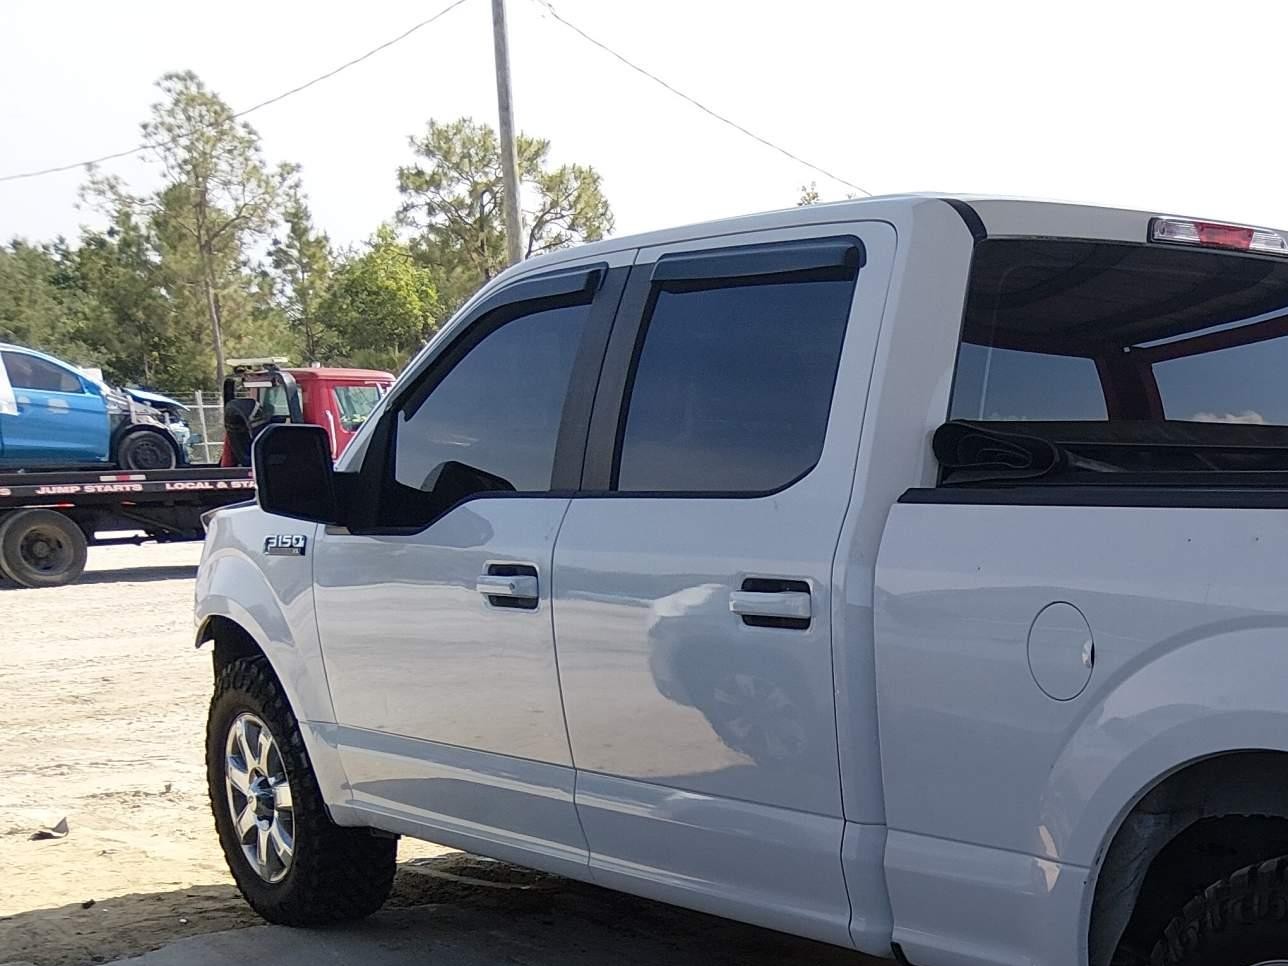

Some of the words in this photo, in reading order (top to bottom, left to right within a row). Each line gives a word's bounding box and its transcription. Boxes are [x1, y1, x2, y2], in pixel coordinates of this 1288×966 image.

[35, 486, 81, 494] JUMP
[83, 484, 143, 492] STARTS
[165, 482, 214, 490] LOCAL
[216, 481, 228, 489] &
